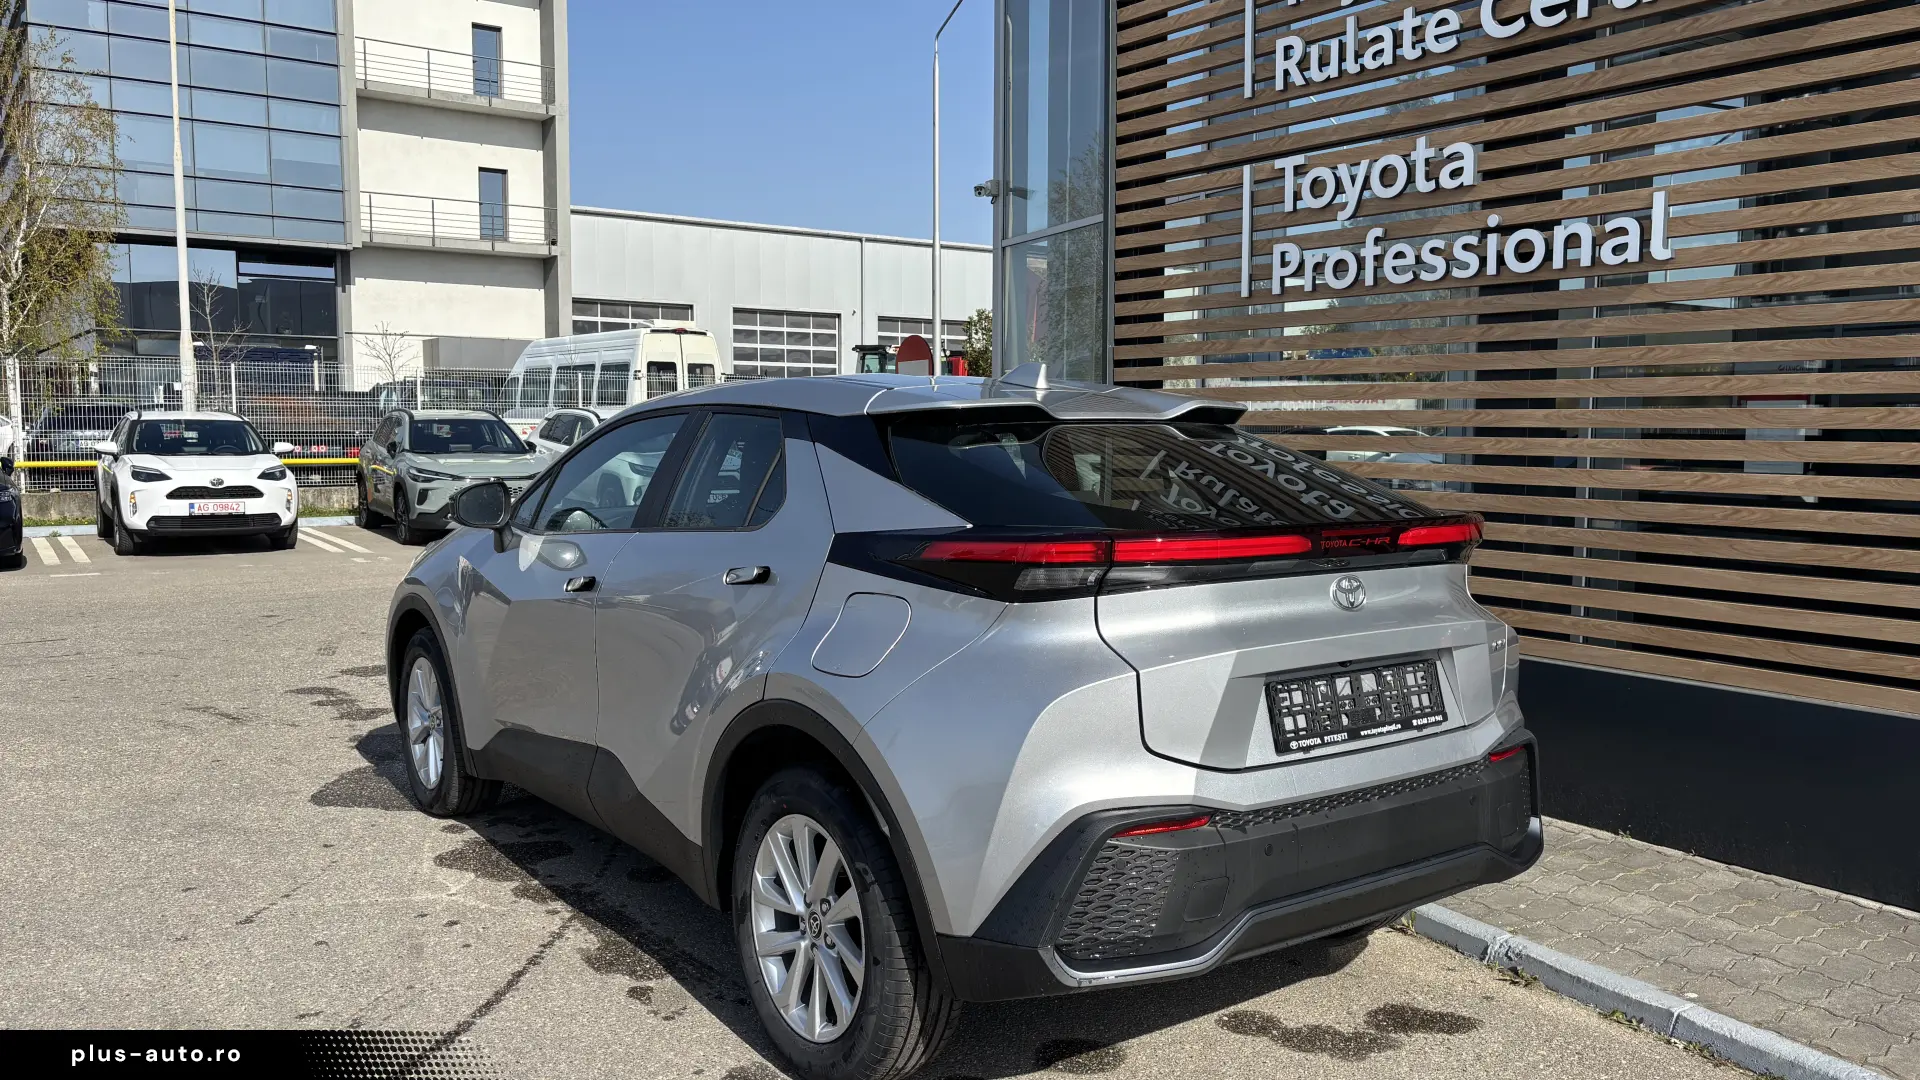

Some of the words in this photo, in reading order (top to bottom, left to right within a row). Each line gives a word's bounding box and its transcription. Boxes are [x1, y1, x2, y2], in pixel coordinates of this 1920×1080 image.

[1275, 7, 1463, 92] Rulate
[1274, 136, 1478, 222] Toyota
[1272, 191, 1672, 297] Professional
[197, 504, 210, 512] AG
[212, 503, 241, 512] 09842
[1320, 540, 1347, 549] TOYOTA
[1349, 537, 1391, 547] C-HR
[1298, 738, 1322, 748] TOYOTA
